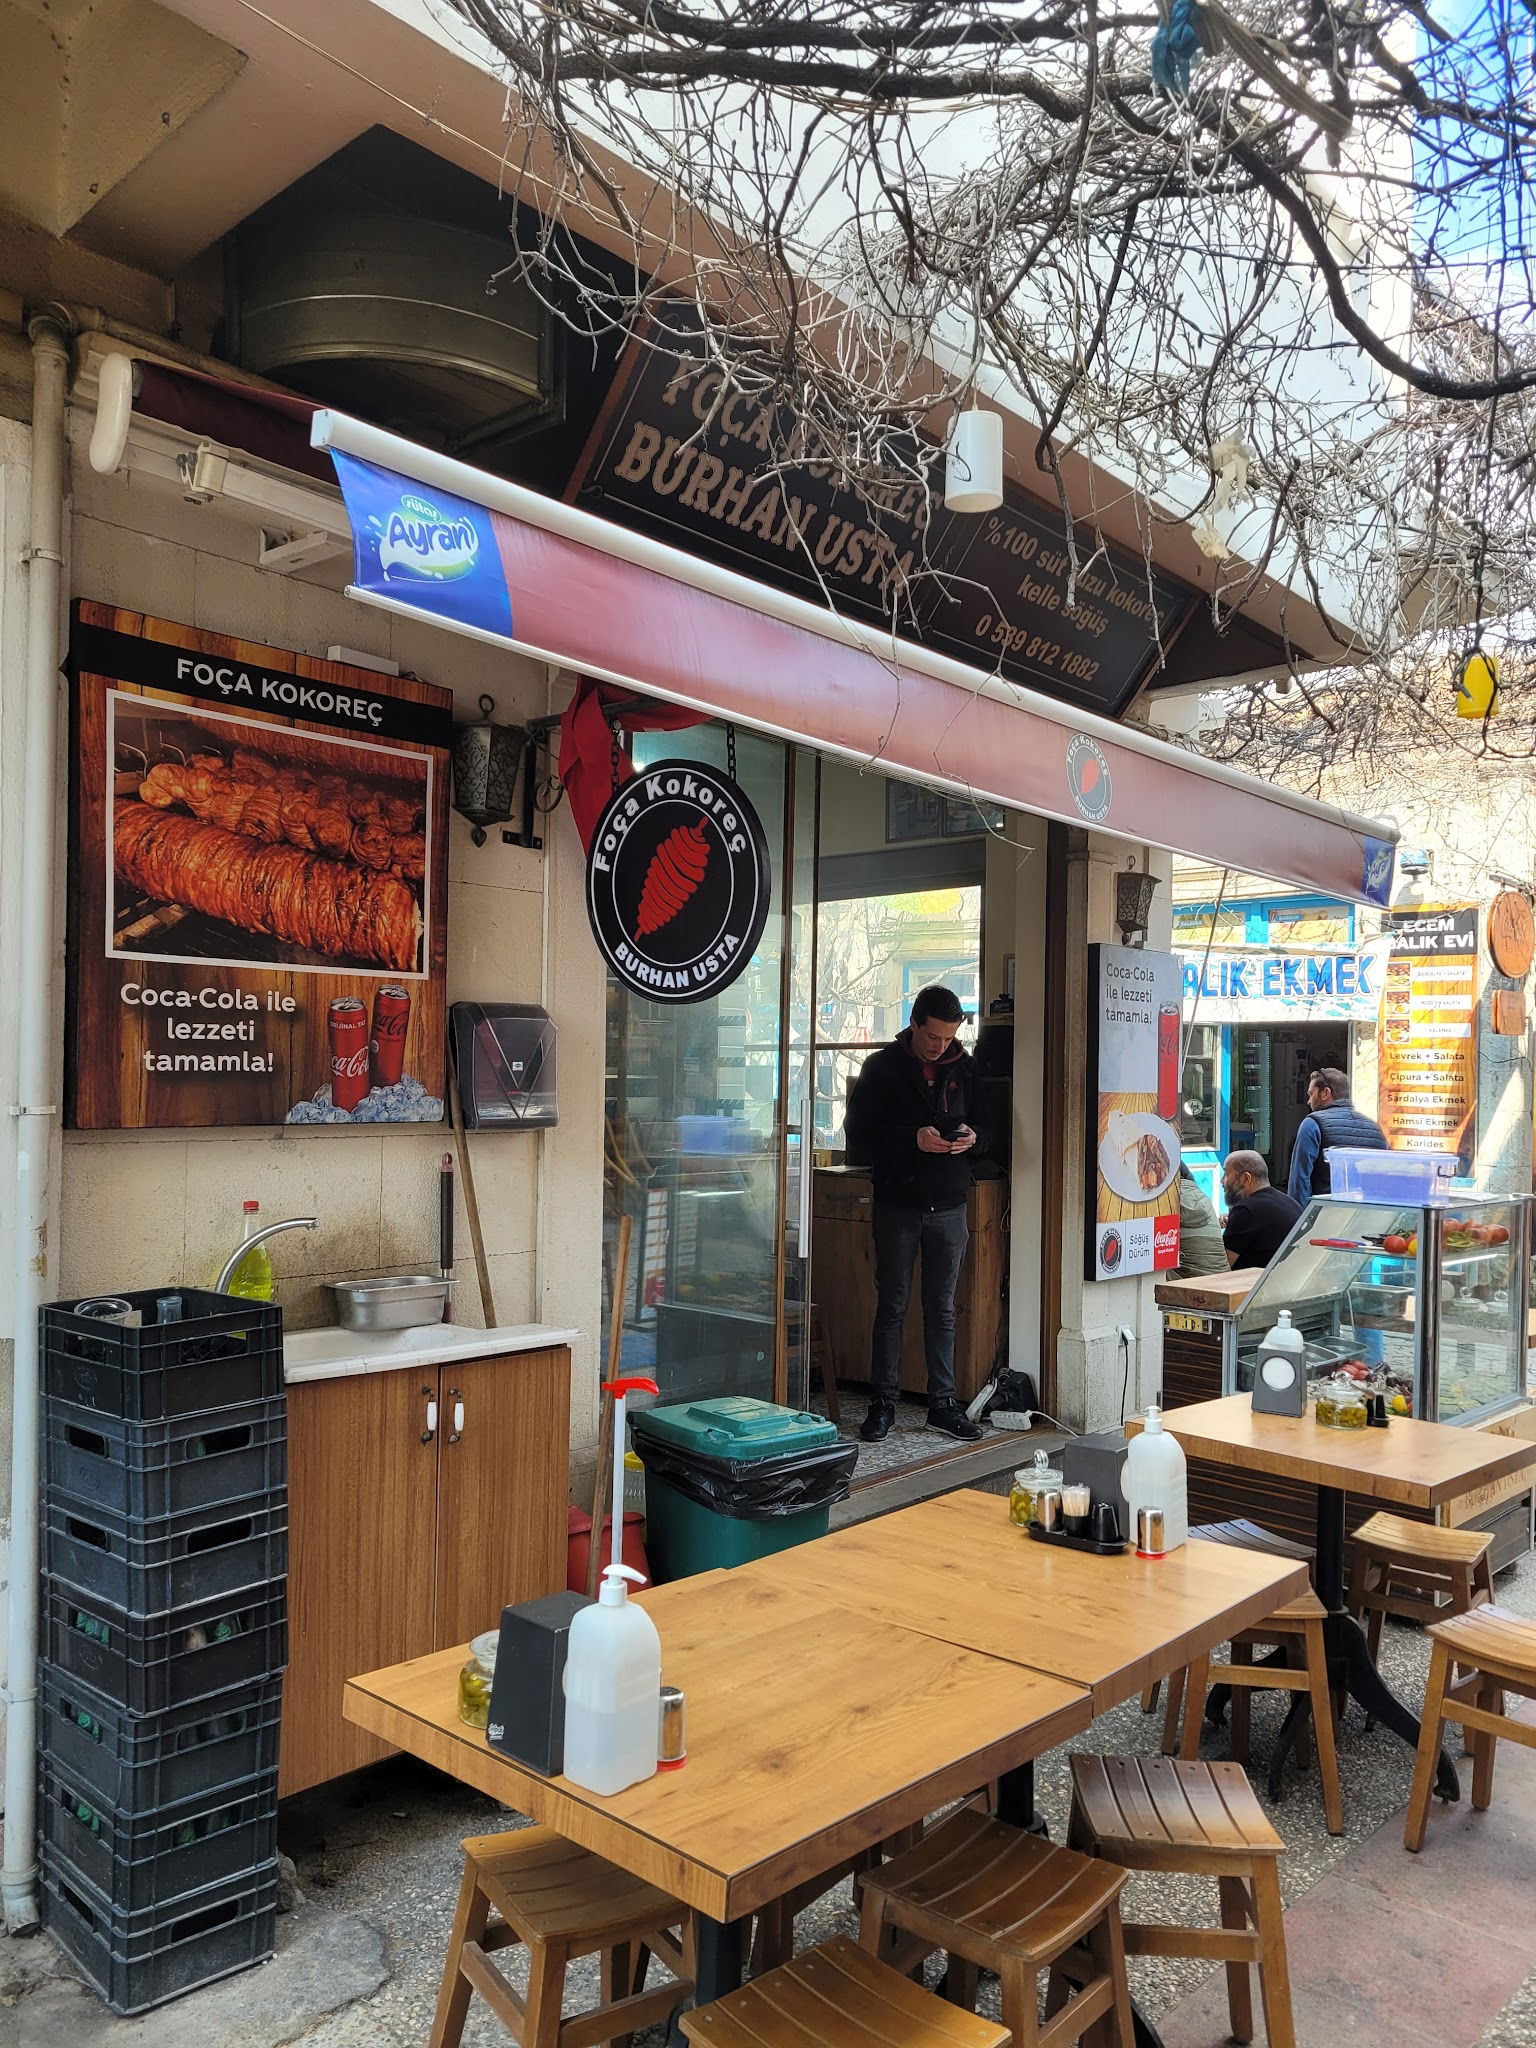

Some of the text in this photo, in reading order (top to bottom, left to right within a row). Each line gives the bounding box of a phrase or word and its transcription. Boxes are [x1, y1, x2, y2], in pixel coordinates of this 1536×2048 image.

[614, 420, 914, 595] BURHAN USTA
[388, 514, 476, 556] Ayran
[984, 516, 1039, 560] %100
[1036, 550, 1069, 577] süt
[1069, 571, 1107, 598] uzu
[1016, 574, 1061, 611] kelle
[975, 615, 992, 637] 0
[1025, 636, 1061, 666] 812
[1059, 651, 1100, 682] 1882
[177, 658, 383, 727] FOÇA KOKOREÇ
[595, 774, 747, 872] Foça Kokoreç
[1391, 930, 1474, 950] ALIK EVİ
[614, 933, 740, 988] BURHAN USTA
[1183, 956, 1375, 998] ALIK EKMEK
[120, 983, 296, 1013] Coca-Cola ile
[1106, 984, 1152, 1003] ile lezzeti
[1106, 1007, 1152, 1024] tamamla!
[167, 1017, 255, 1041] lezzeti
[143, 1050, 274, 1072] tamamla!
[1389, 1050, 1422, 1060] Levrek
[1434, 1051, 1465, 1060] Salata
[1390, 1073, 1421, 1083] Çipura
[1433, 1073, 1464, 1082] Salata
[1387, 1094, 1466, 1104] Sardalya Ekmek
[1392, 1117, 1459, 1127] Hamsi Ekmek
[1406, 1139, 1444, 1148] Karides
[1129, 1248, 1150, 1259] Dürüm
